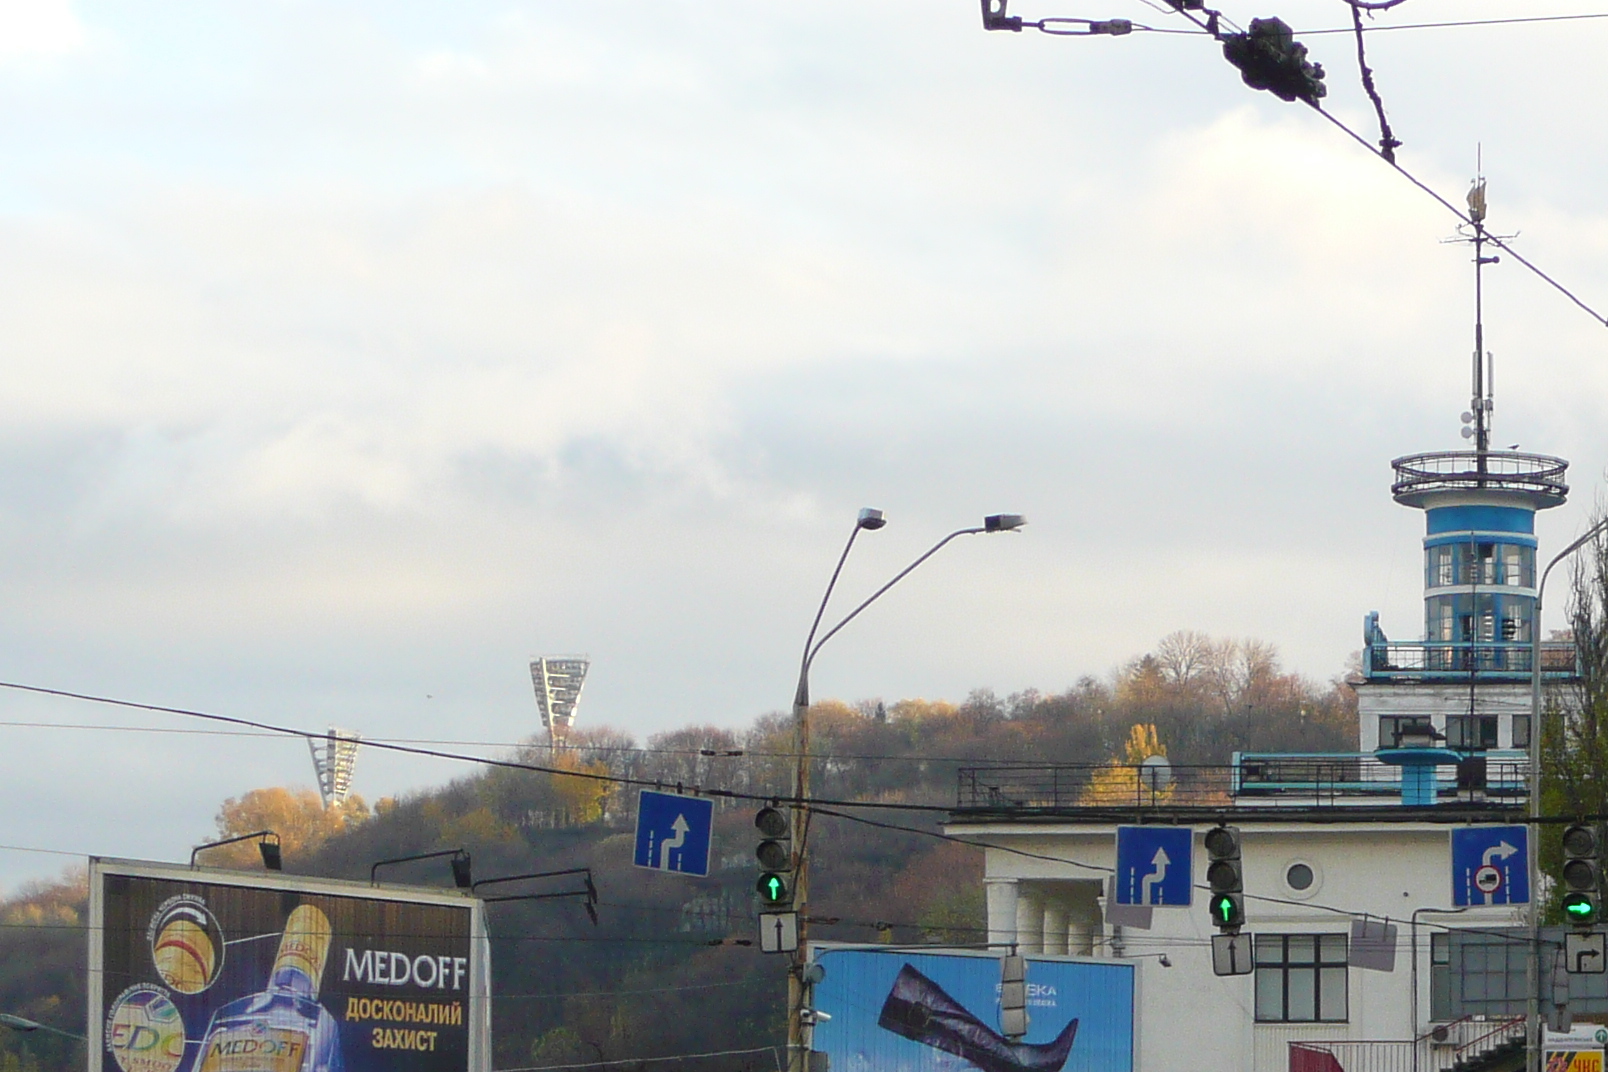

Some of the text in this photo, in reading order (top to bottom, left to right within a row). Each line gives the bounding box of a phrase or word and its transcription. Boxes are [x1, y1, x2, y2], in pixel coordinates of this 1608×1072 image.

[343, 948, 467, 990] MEDOFF
[345, 997, 462, 1025] ДОСКОНАЛИЙ
[210, 1039, 302, 1058] MEDOFF
[372, 1027, 437, 1051] ЗАХИСТ
